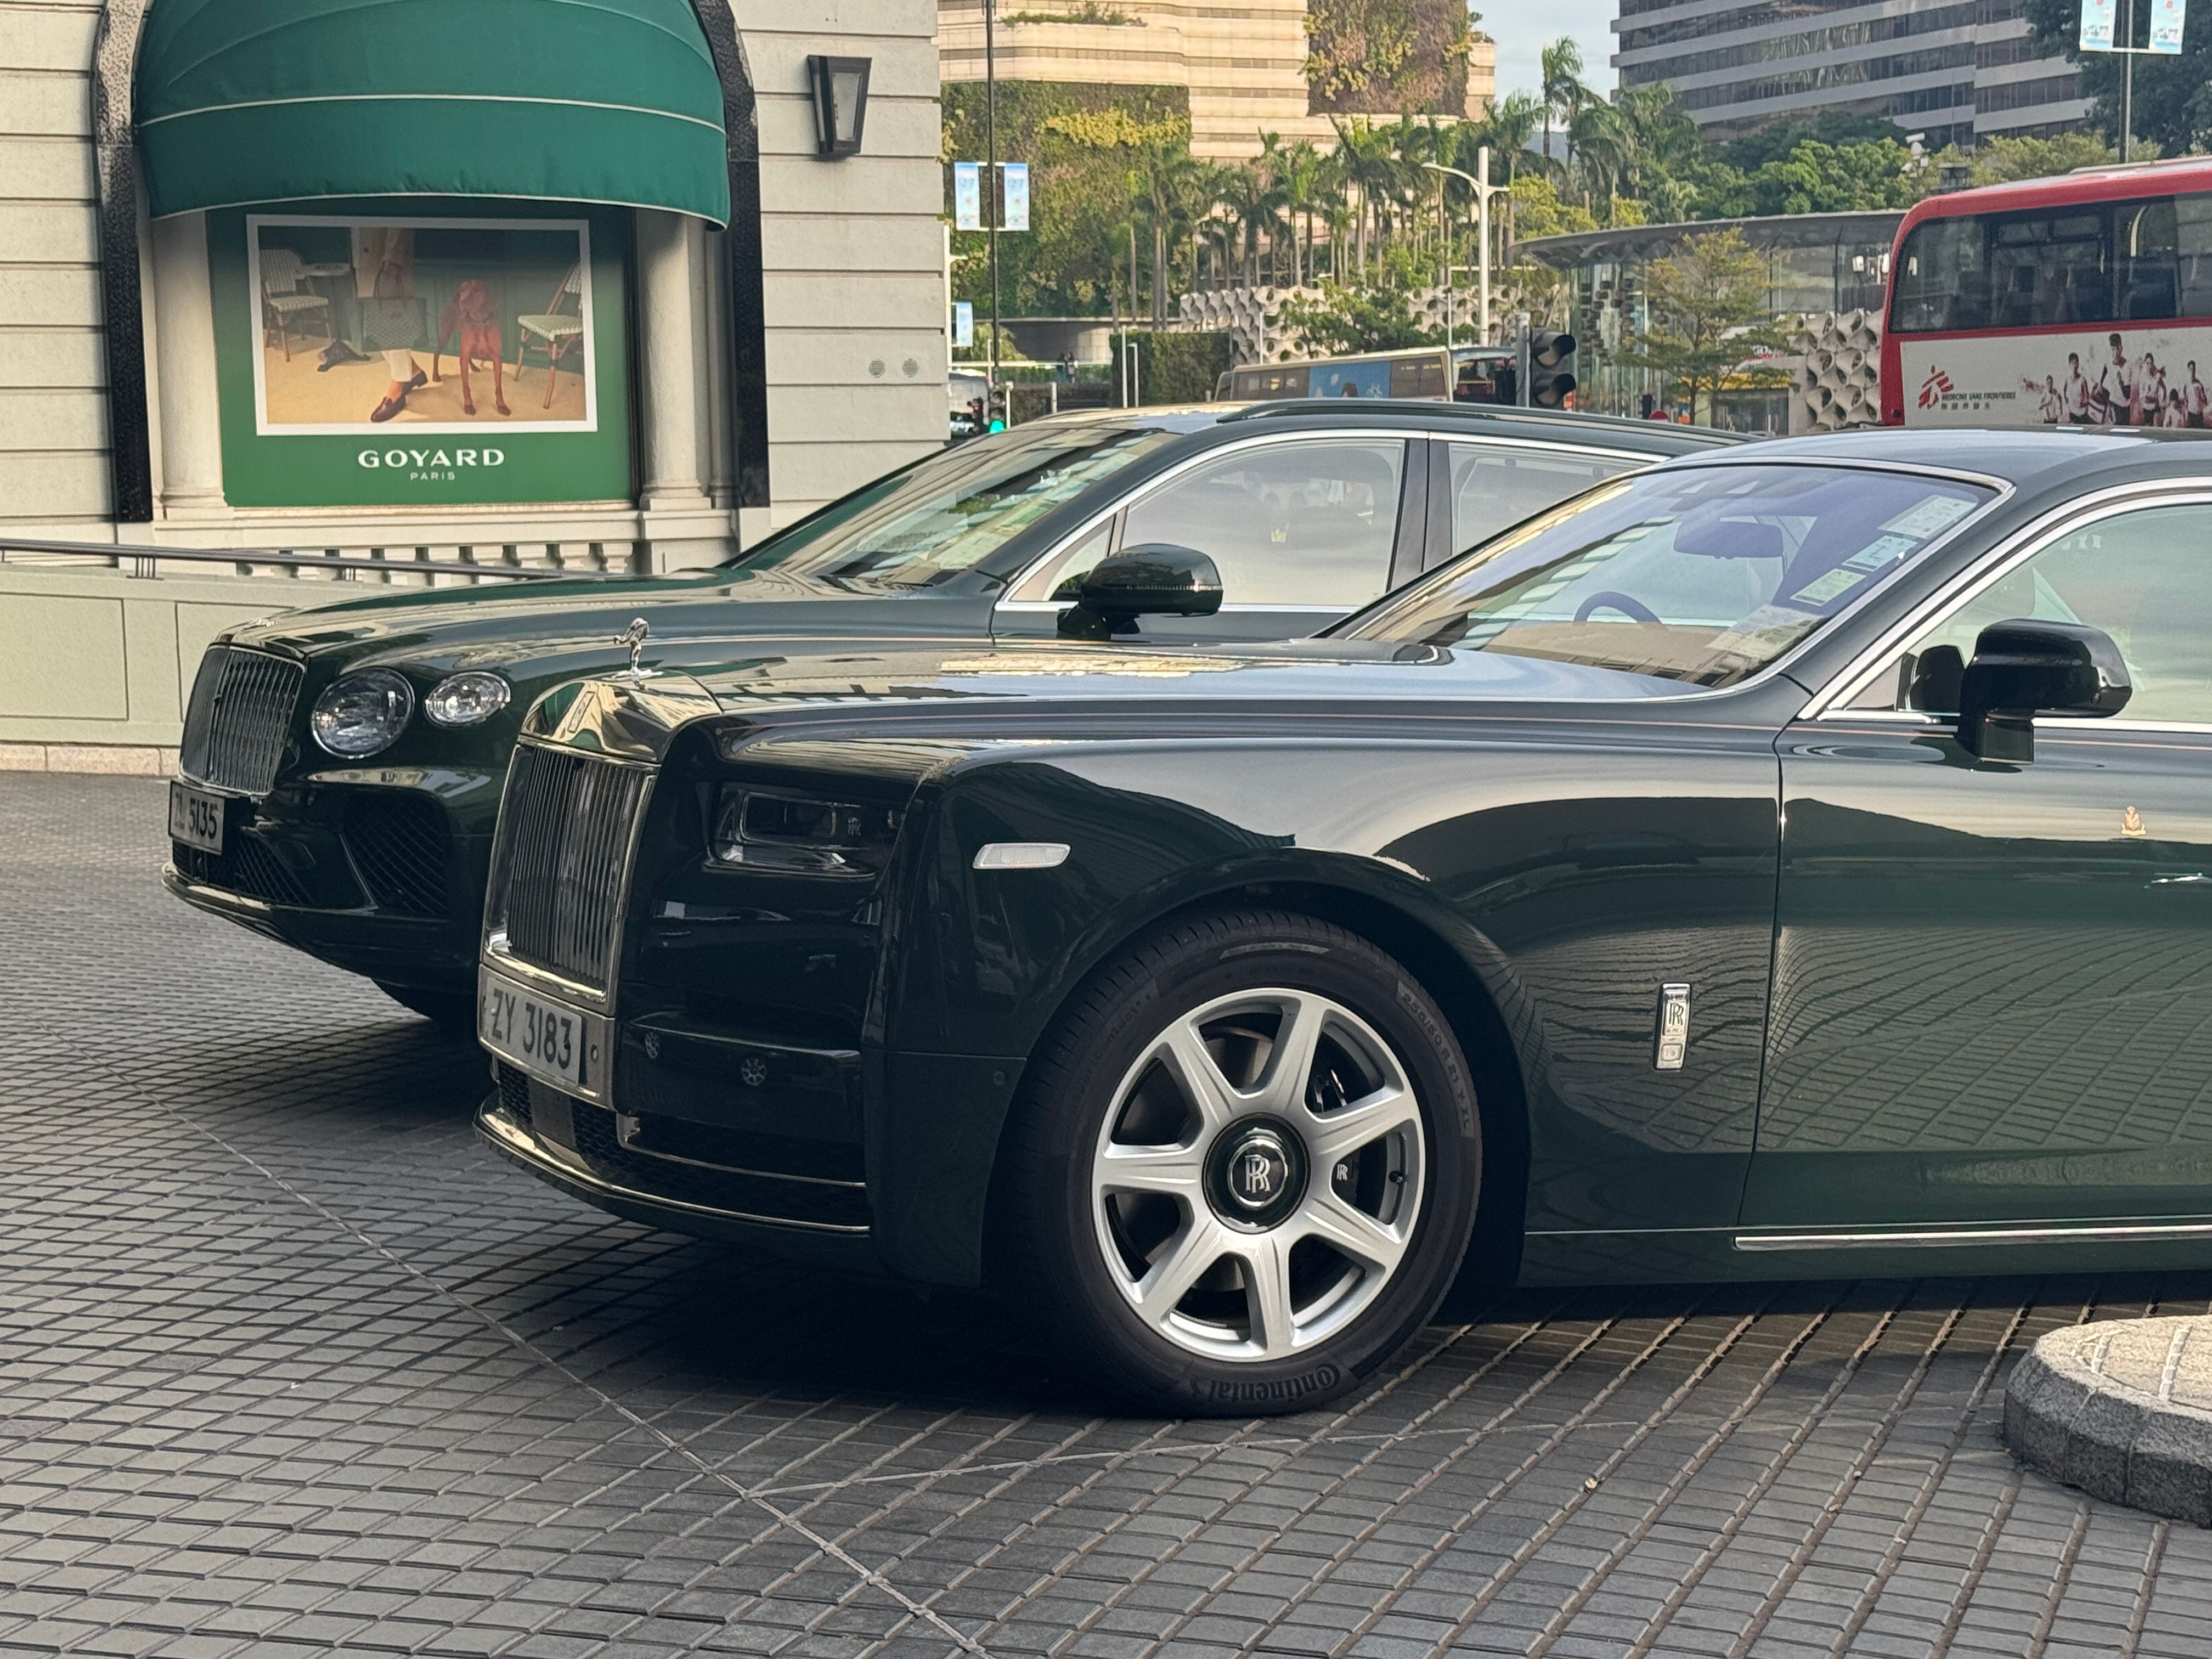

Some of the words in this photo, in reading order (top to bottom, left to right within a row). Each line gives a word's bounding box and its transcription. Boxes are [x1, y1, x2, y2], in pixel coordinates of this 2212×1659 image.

[358, 449, 505, 468] GOYARD
[410, 471, 456, 481] PARIS
[188, 797, 218, 839] 5135
[492, 988, 516, 1044] ZY
[523, 1002, 572, 1070] 3183
[1244, 1154, 1271, 1193] RR
[1207, 1363, 1341, 1401] Continental
